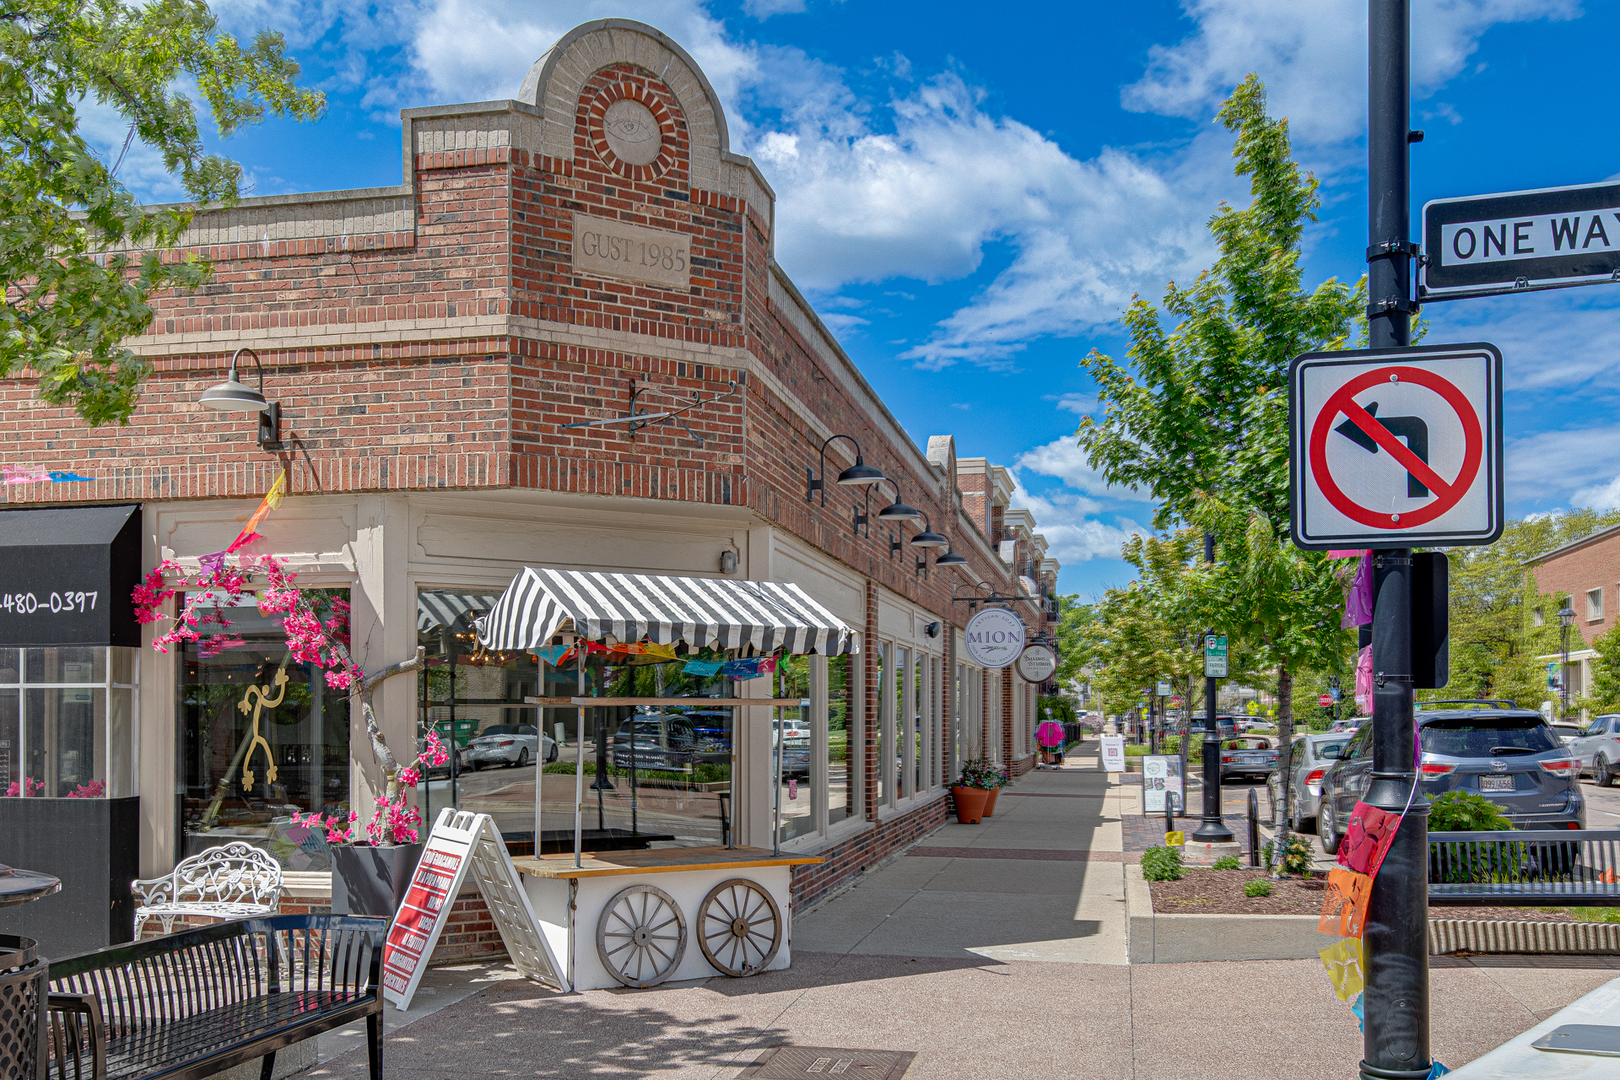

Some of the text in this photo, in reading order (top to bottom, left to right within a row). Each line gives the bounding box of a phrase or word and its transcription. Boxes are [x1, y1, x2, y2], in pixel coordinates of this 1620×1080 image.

[1453, 212, 1620, 260] ONE WA
[582, 231, 686, 272] GUST 1985
[0, 591, 98, 614] 480-0397
[975, 614, 999, 628] ARTISAN
[968, 630, 1020, 643] MION
[978, 653, 997, 662] NATURAL
[418, 915, 434, 931] TACOS
[388, 950, 416, 972] MARGARITAS
[384, 972, 407, 992] COCKTAILS
